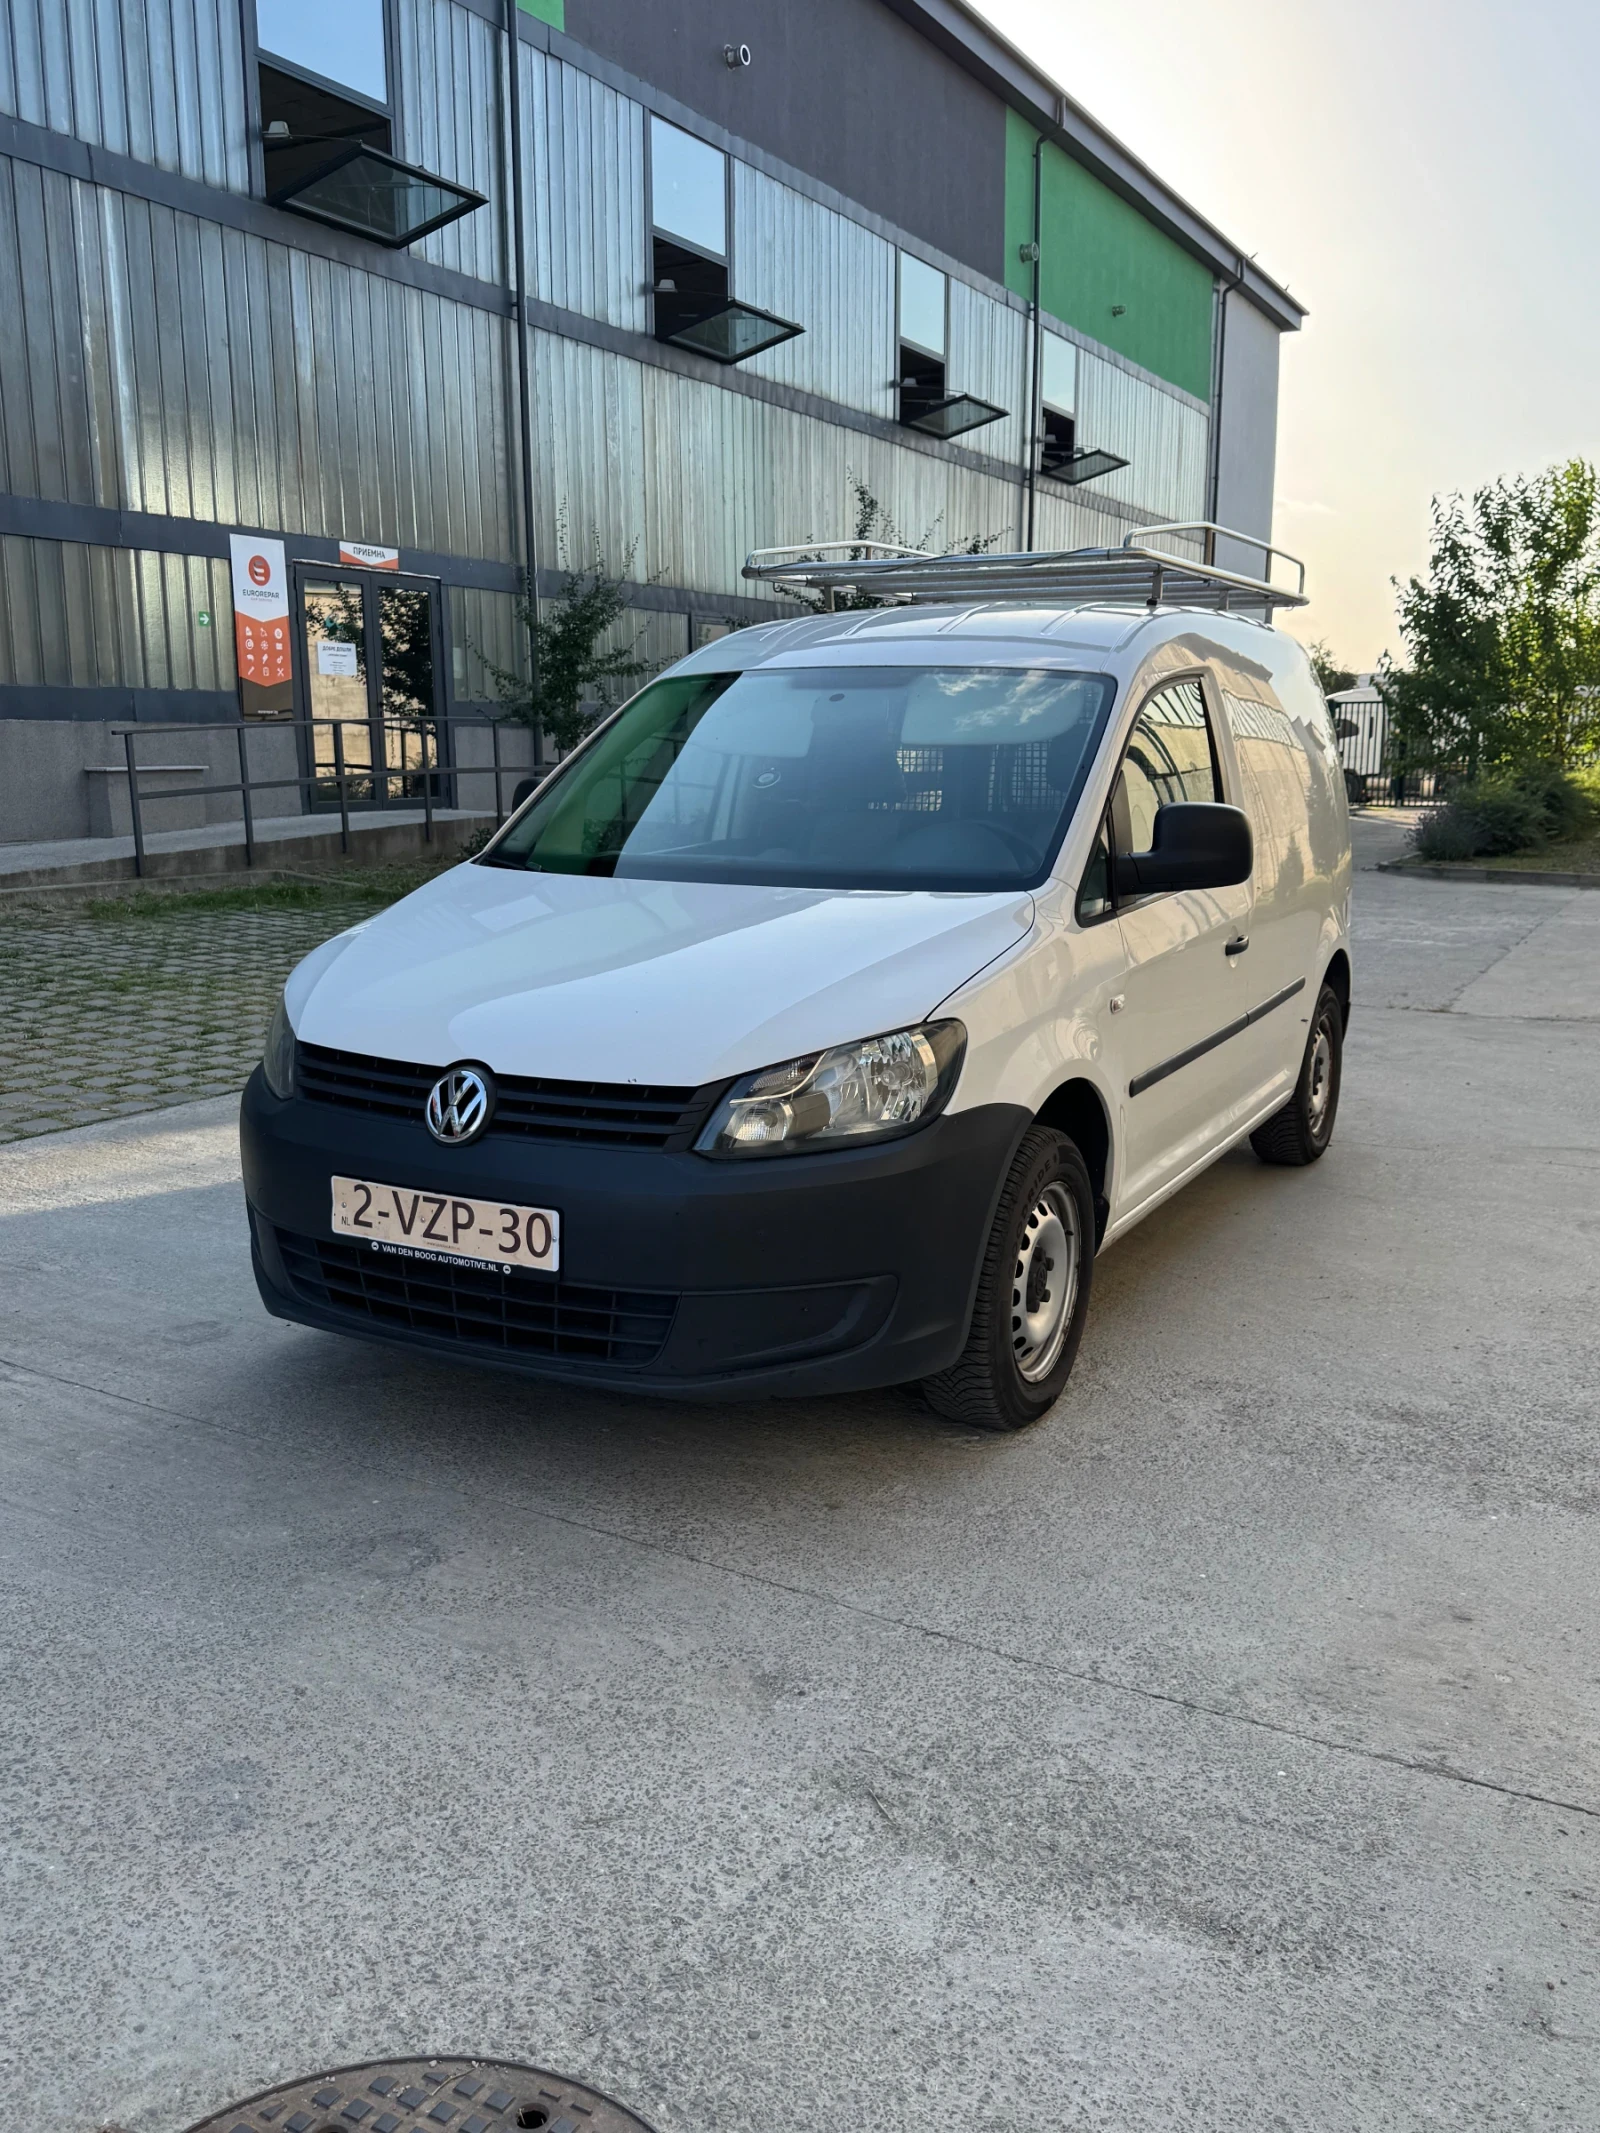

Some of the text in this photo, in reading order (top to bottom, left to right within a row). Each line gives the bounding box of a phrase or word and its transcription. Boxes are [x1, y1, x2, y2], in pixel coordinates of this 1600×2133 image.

[353, 547, 385, 559] ПРИЕМНА
[242, 589, 279, 599] EUROREPAR
[353, 1184, 551, 1258] 2-VZP-30
[382, 1244, 499, 1272] VAN DEN BOOG AUTOMOTIVE.NL
